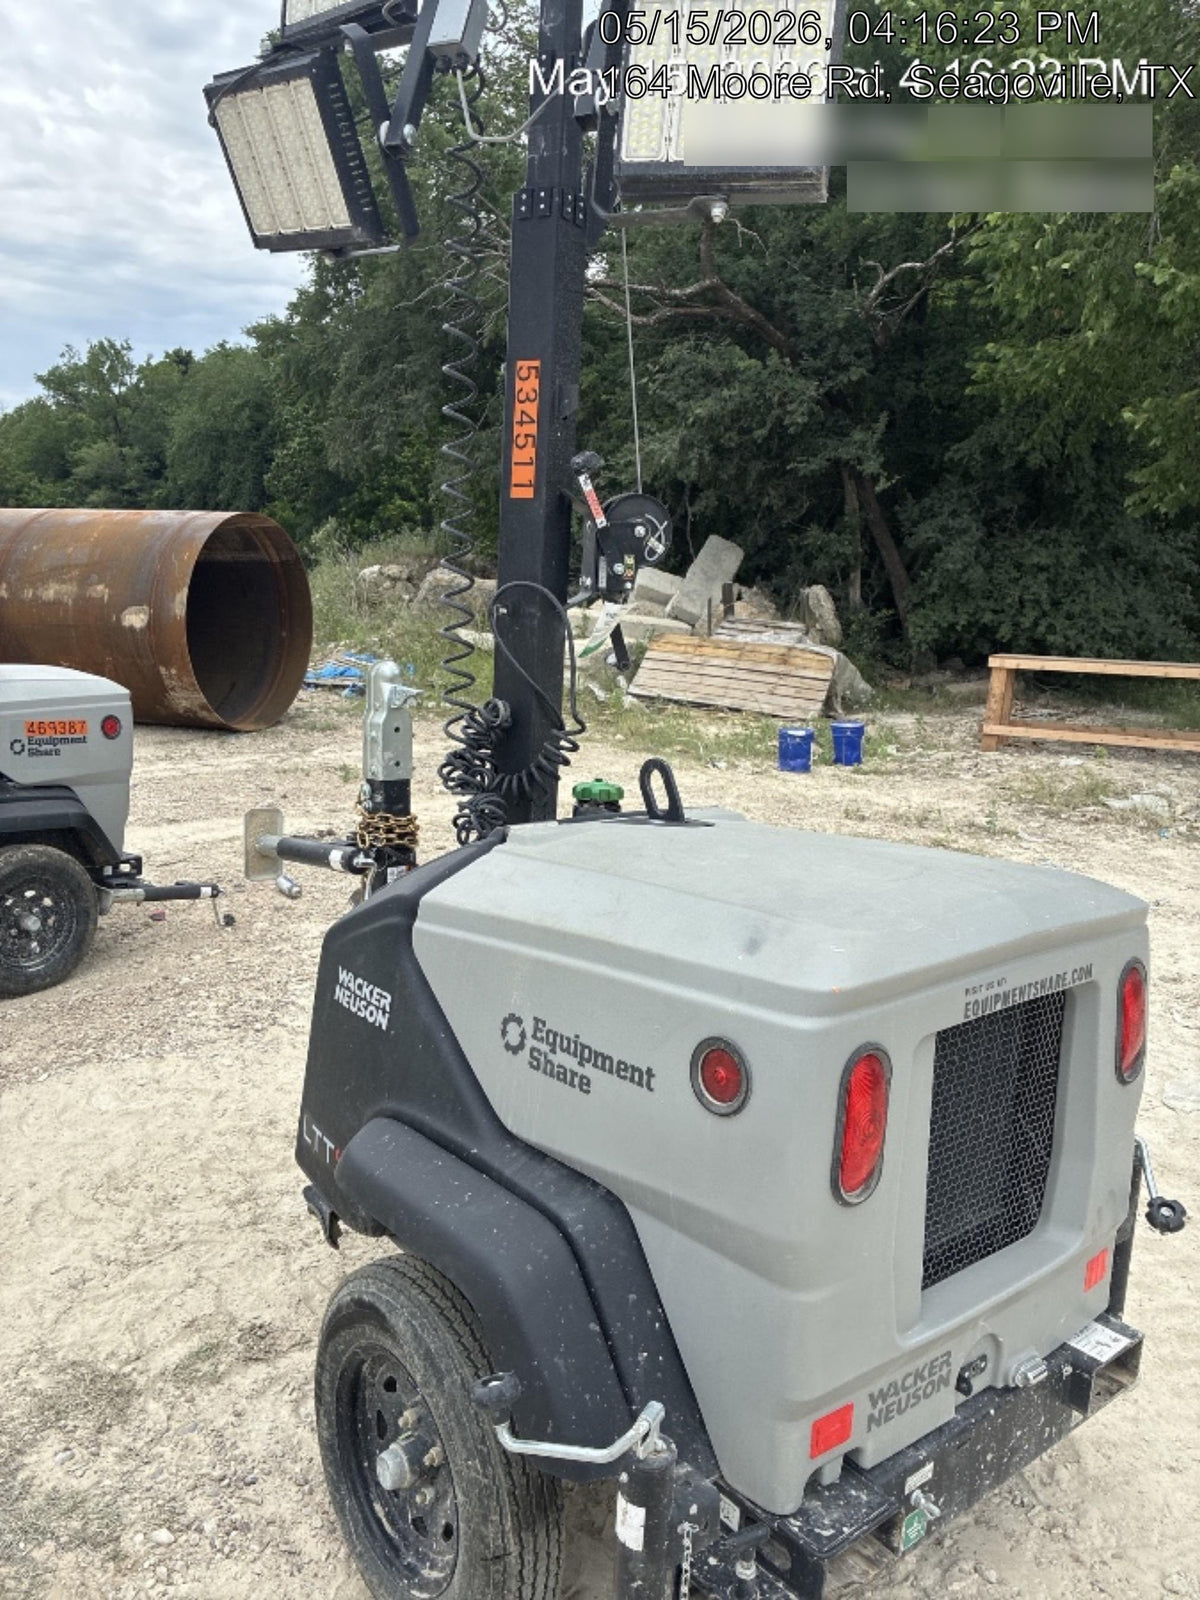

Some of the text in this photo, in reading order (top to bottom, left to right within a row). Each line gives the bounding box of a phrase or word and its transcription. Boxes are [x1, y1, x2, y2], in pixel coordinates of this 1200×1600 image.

[512, 364, 540, 490] 534511
[28, 735, 87, 747] Equipment
[28, 747, 61, 757] Share
[334, 984, 390, 1031] NEUSON
[338, 965, 392, 1013] WACKER
[963, 963, 1093, 1020] EQUIPMENTSHARE.COM
[528, 1046, 591, 1095] Share
[531, 1016, 655, 1092] Equipment
[866, 1368, 952, 1434] NEUSON
[868, 1350, 952, 1411] WACKER
